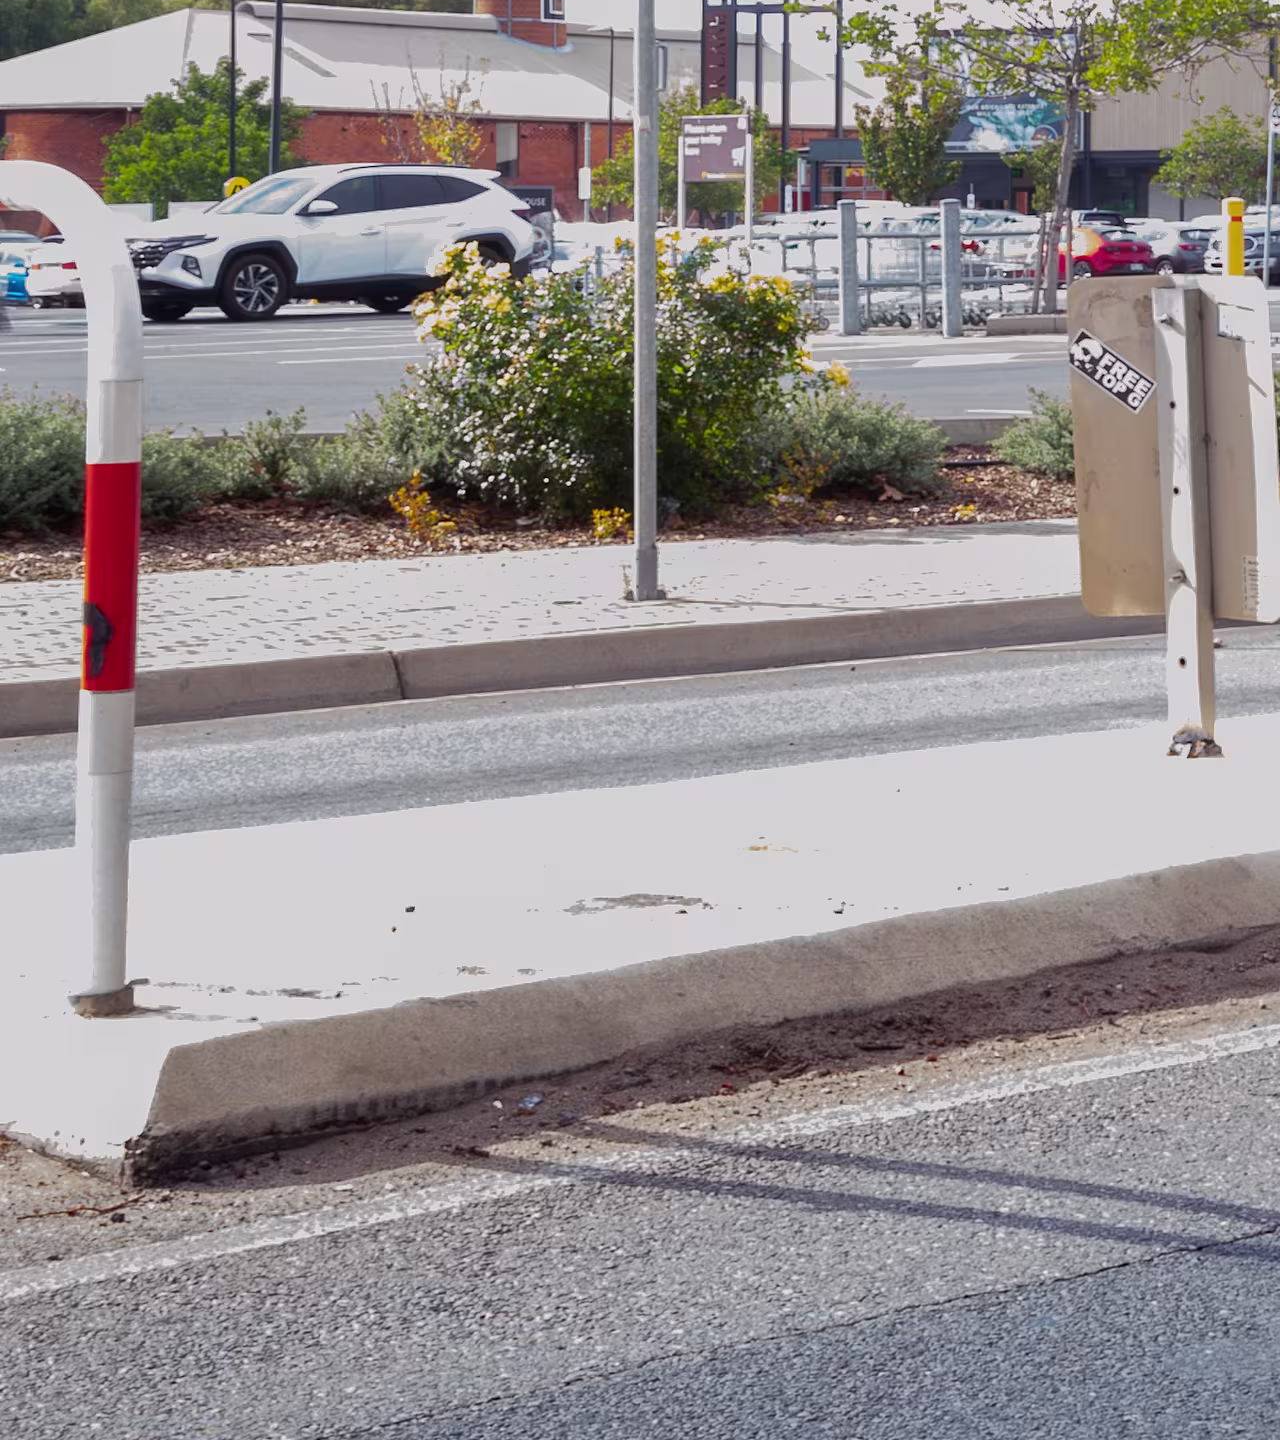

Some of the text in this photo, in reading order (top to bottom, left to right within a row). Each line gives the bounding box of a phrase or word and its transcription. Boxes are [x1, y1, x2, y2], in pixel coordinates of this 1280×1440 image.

[1094, 365, 1142, 408] TOP G
[1099, 352, 1152, 397] FREE
